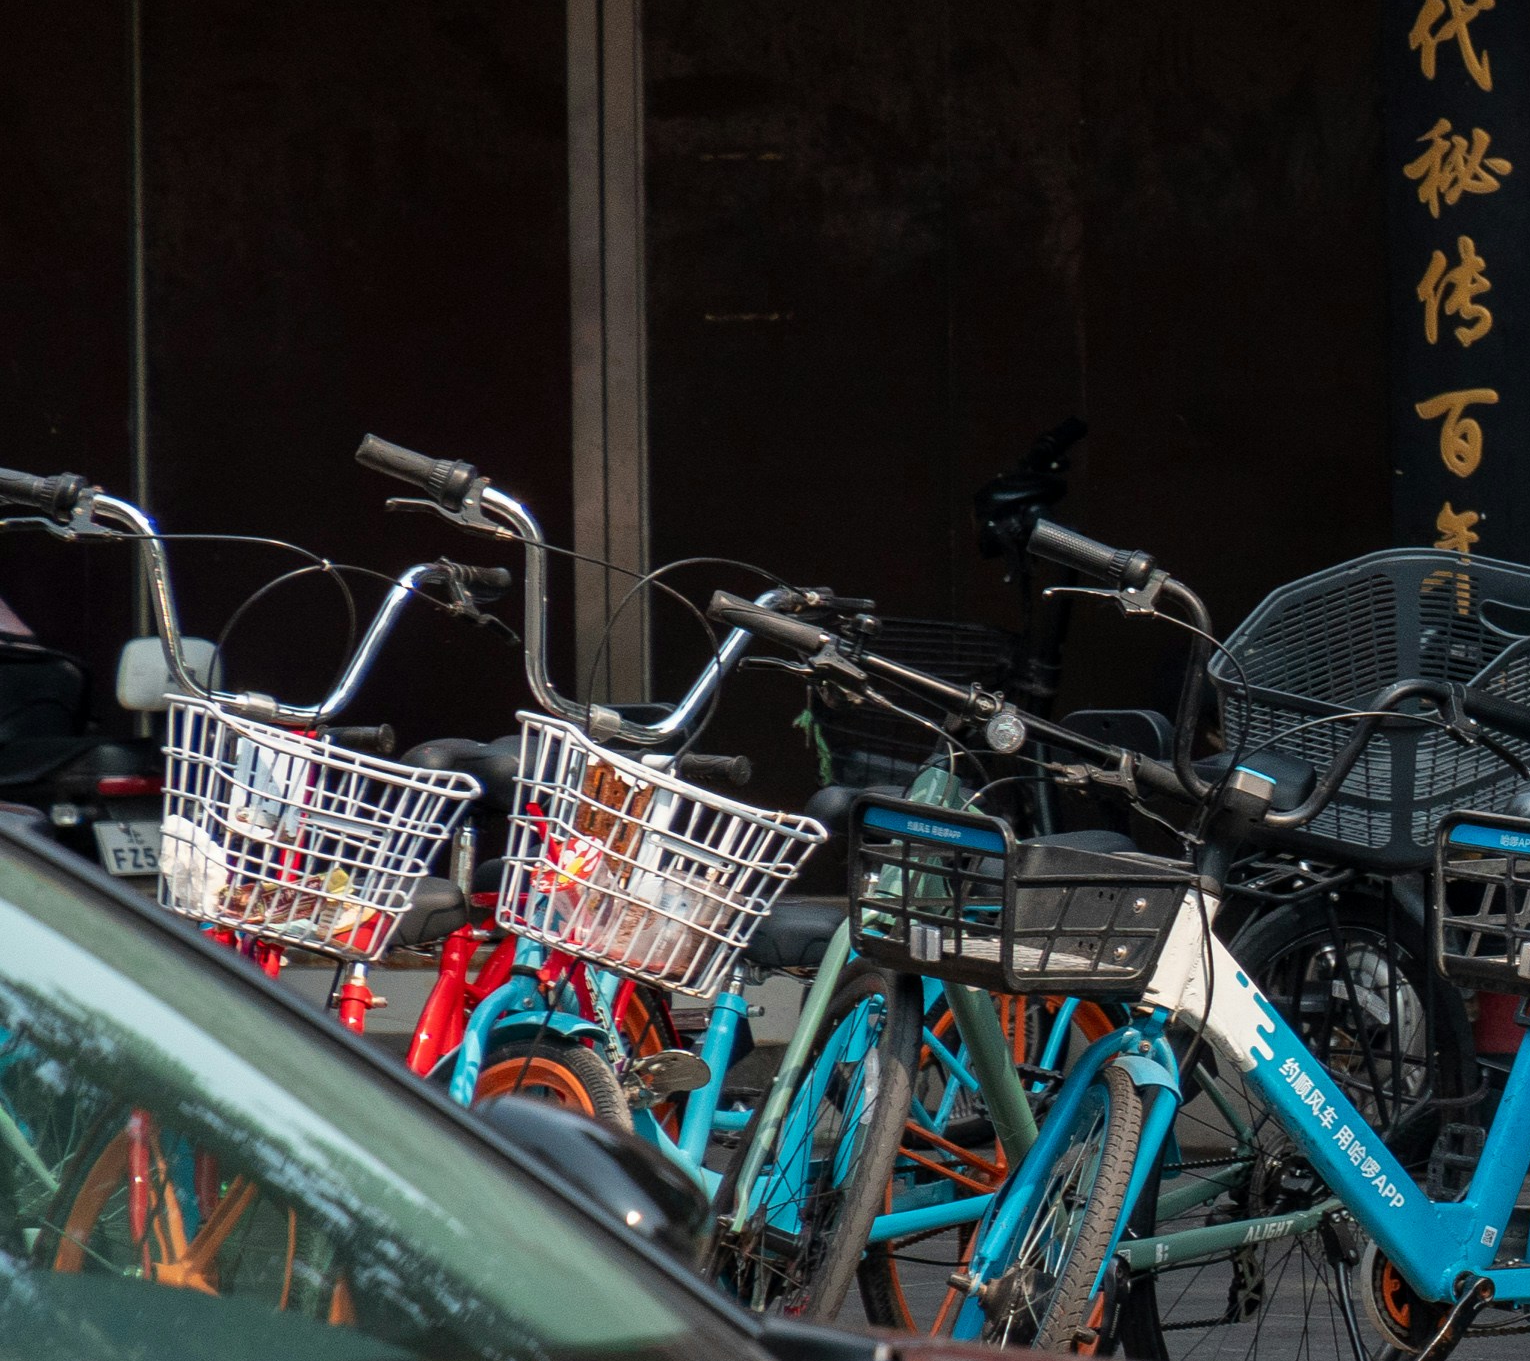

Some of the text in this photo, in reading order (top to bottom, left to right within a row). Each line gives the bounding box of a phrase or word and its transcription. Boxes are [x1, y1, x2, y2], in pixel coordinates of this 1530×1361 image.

[1278, 1057, 1405, 1208] 约顺风车 用哈啰APP
[1242, 1220, 1295, 1244] ALIGHT
